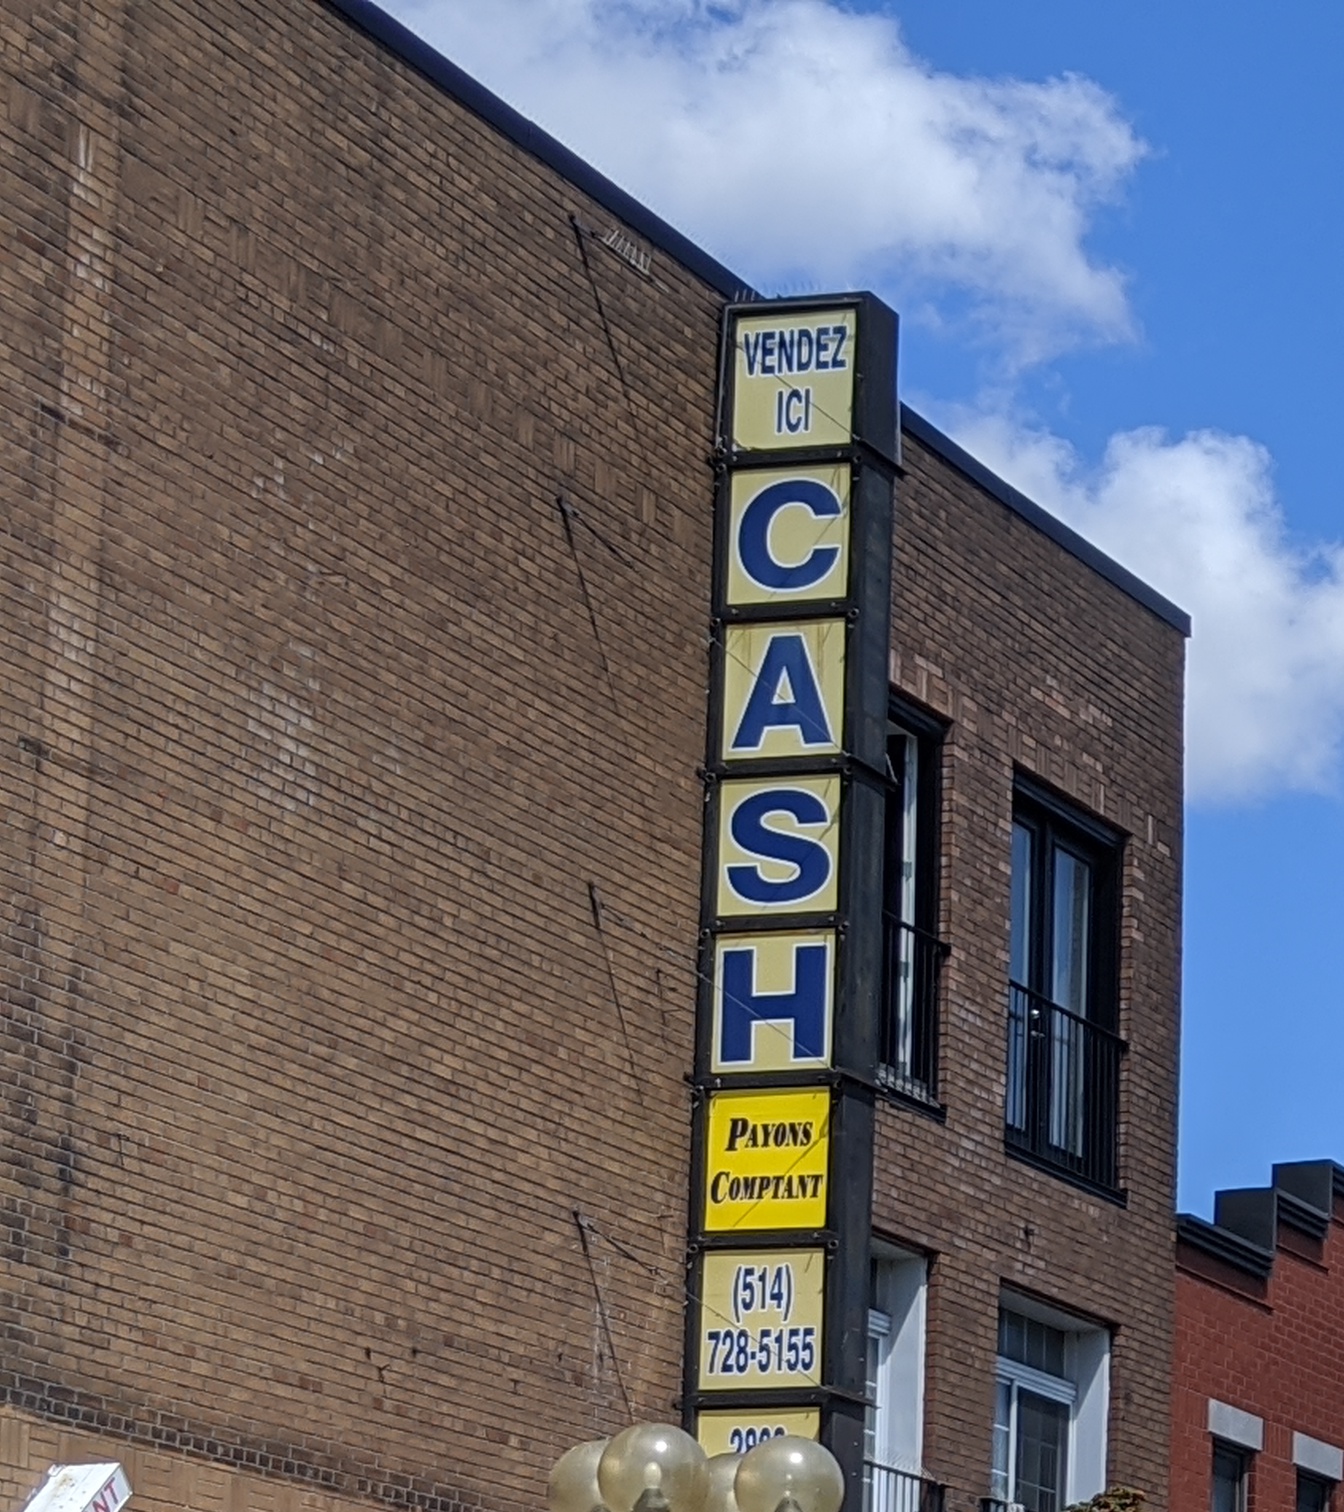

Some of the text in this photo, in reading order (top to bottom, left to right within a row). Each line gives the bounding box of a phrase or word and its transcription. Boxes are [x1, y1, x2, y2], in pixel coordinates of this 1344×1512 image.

[744, 325, 848, 377] VENDEZ
[775, 387, 812, 435] ICI
[718, 477, 843, 1066] CASH
[725, 1117, 813, 1153] PAYONS
[710, 1170, 824, 1205] COMPTANT
[732, 1264, 792, 1322] (514)
[706, 1326, 816, 1376] 728-5155
